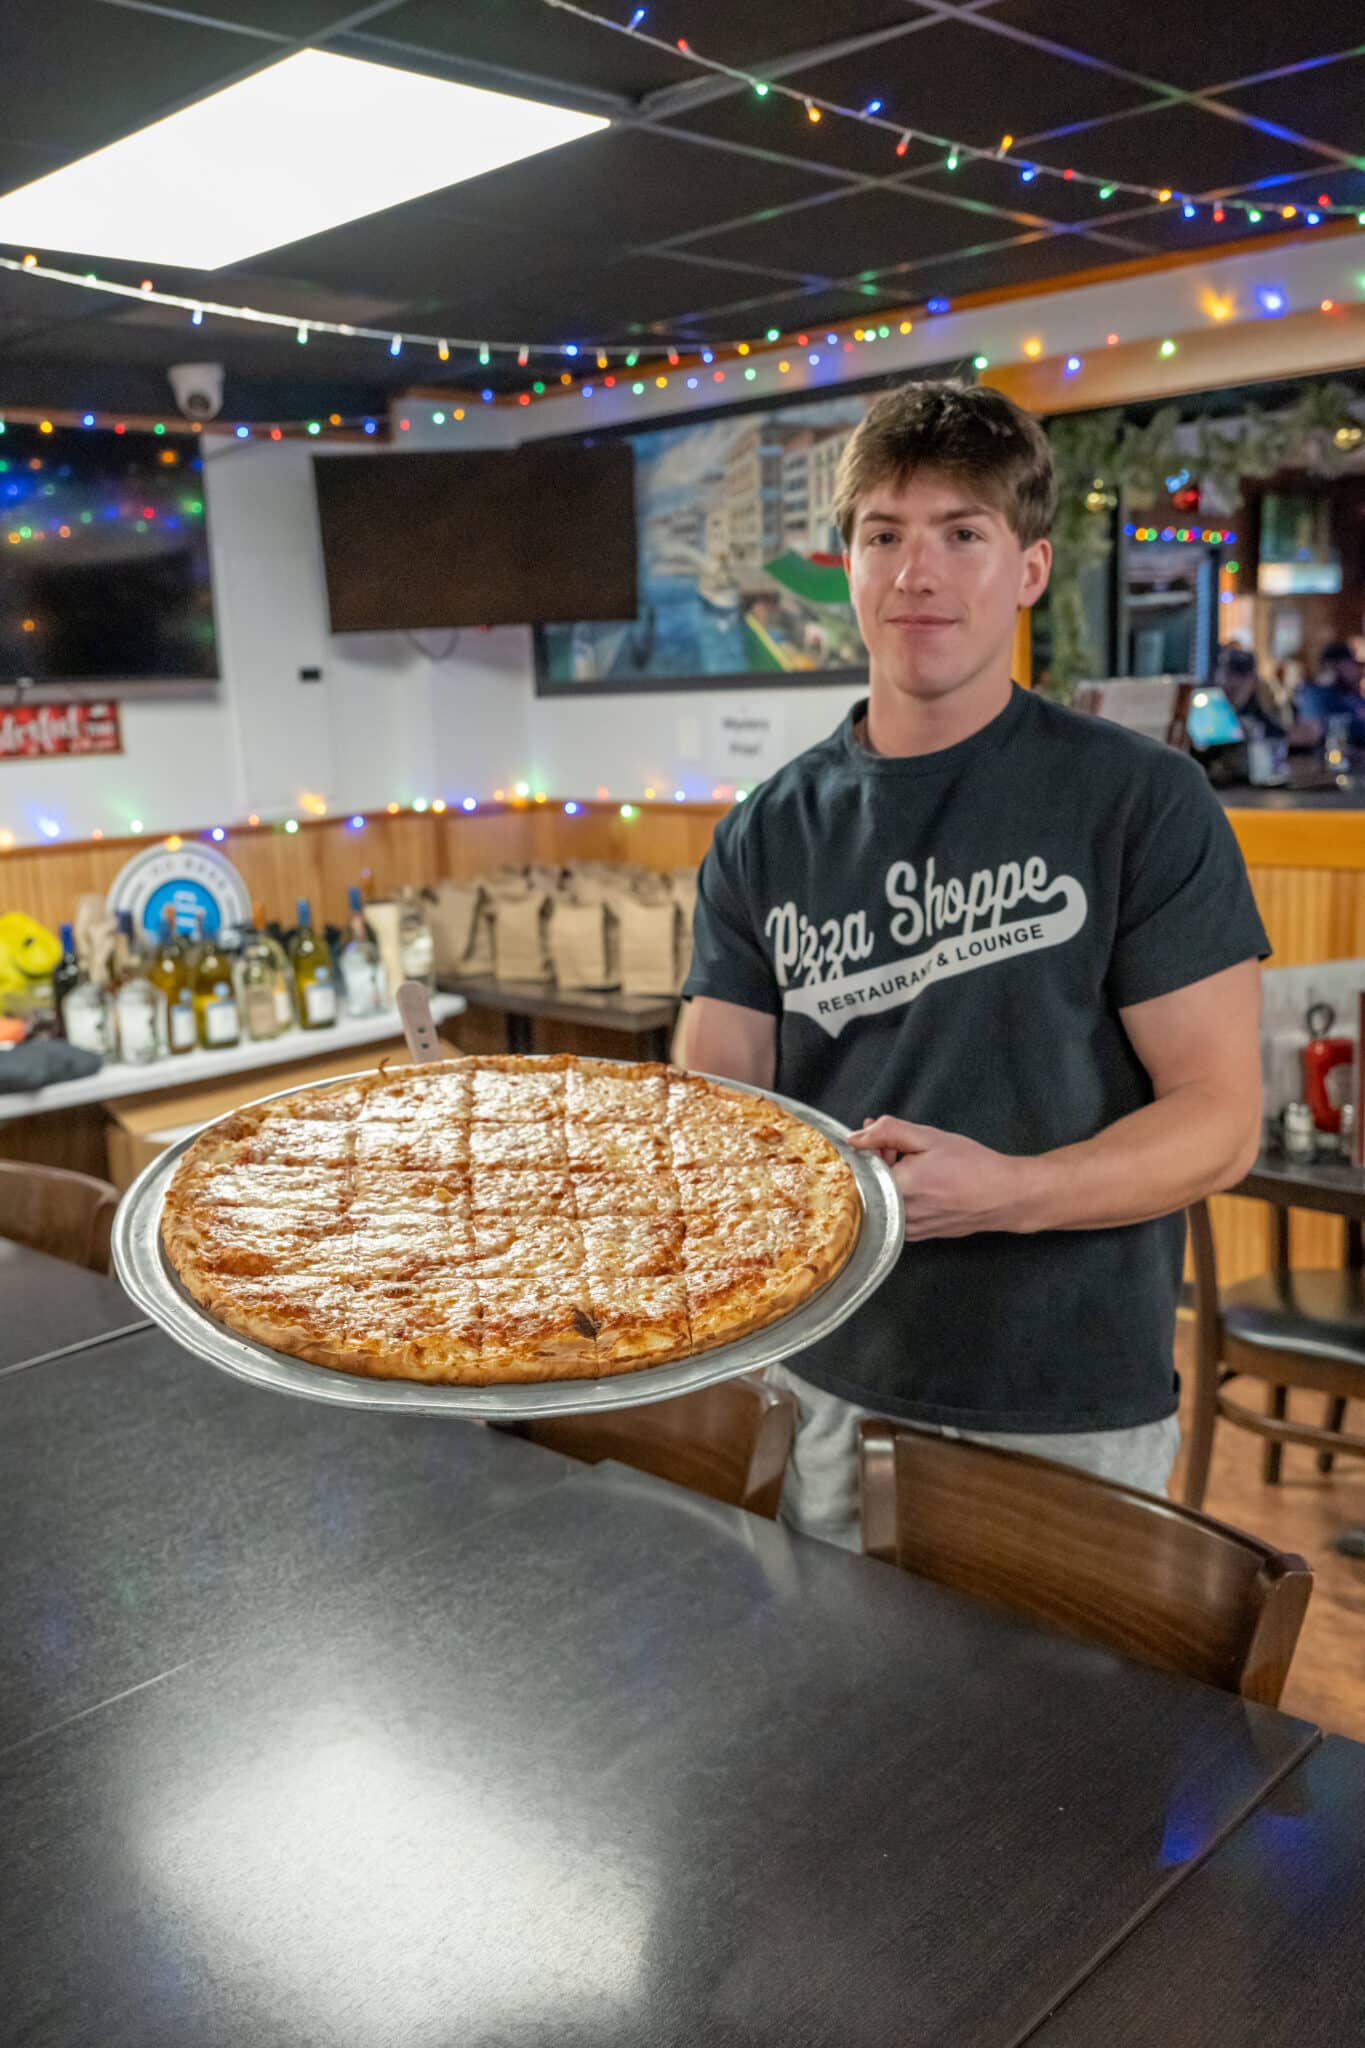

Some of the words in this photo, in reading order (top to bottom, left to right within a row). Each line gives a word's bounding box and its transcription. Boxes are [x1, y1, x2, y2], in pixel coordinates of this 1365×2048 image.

[765, 901, 875, 987] Pizza
[885, 856, 1049, 946] Shoppe
[936, 951, 948, 967] &
[956, 923, 1044, 962] LOUNGE
